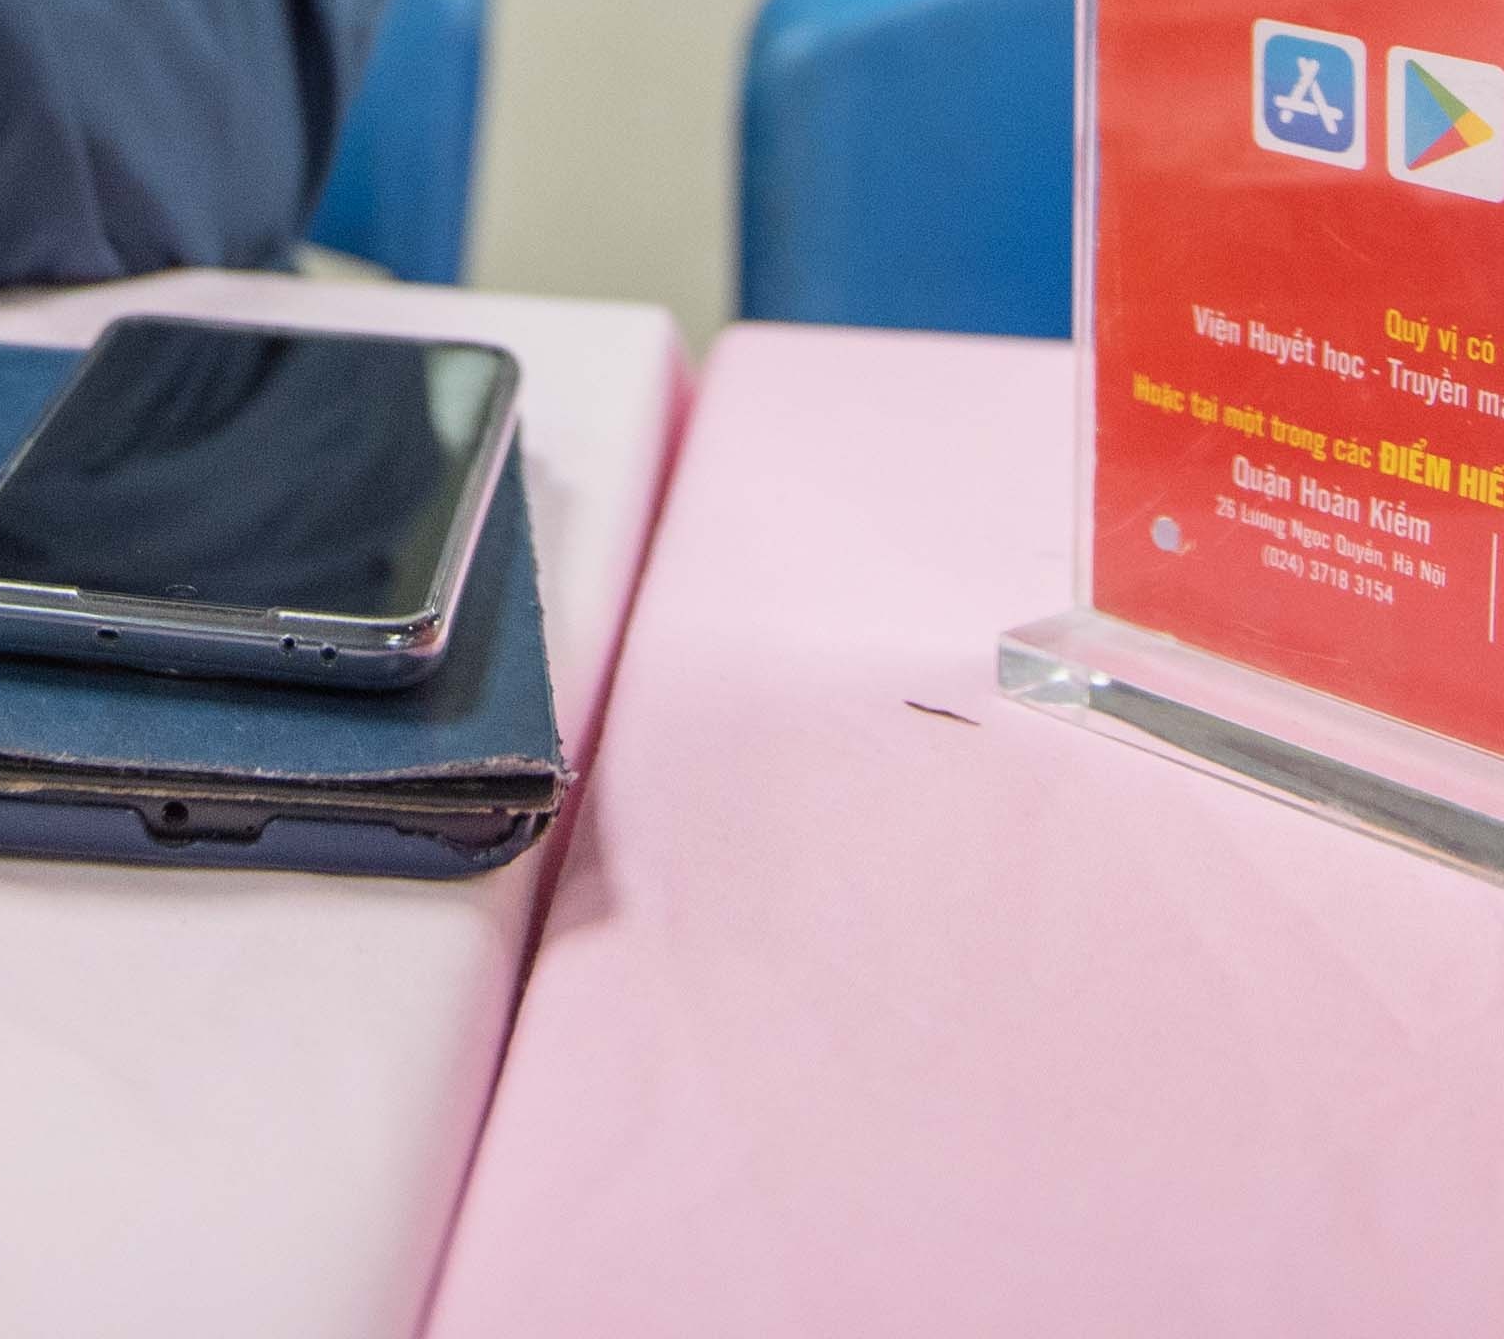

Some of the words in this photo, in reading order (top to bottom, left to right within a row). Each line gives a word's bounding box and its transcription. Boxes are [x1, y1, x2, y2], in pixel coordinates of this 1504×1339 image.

[1385, 306, 1430, 354] Quý
[1437, 326, 1459, 364] vị
[1467, 329, 1496, 366] có
[1191, 390, 1218, 427] tại
[1222, 405, 1265, 442] một
[1333, 432, 1373, 470] các
